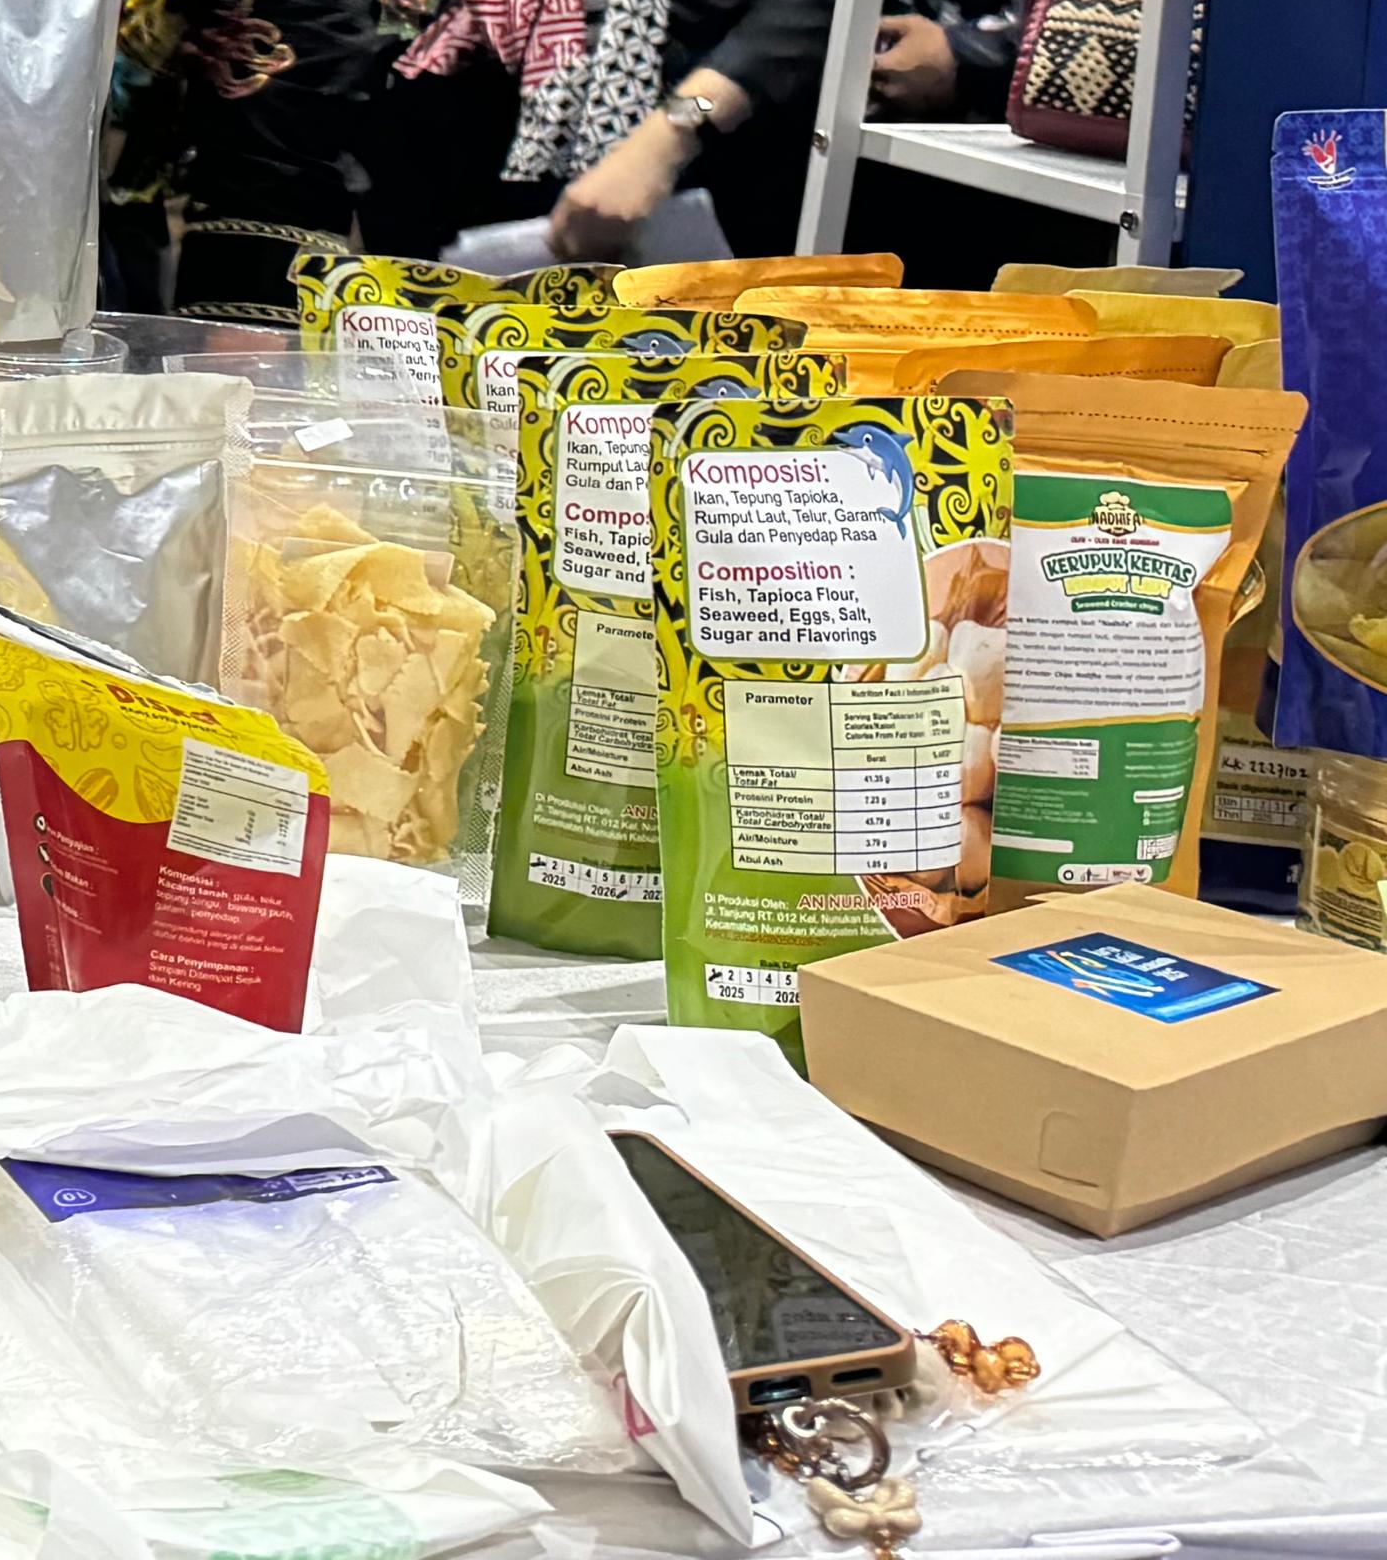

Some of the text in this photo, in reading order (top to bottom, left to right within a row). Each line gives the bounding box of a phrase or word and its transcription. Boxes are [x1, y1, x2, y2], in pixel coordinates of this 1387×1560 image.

[567, 441, 649, 456] Ikan, Tepung
[566, 458, 623, 475] Rumput
[688, 458, 829, 489] Komposisi:
[565, 474, 632, 490] Gula dan
[694, 490, 843, 508] Ikan, Tepung Tapioka,
[694, 508, 886, 527] Rumput Laut, Telur, Garam,
[1091, 510, 1141, 527] NADHIFA
[564, 527, 603, 545] Fish,
[695, 528, 877, 546] Gula dan Penyedap Rasa
[563, 542, 640, 566] Seaweed,
[562, 559, 645, 583] Sugar and
[698, 560, 842, 586] Composition
[1046, 552, 1193, 583] KERUPUK KERTAS
[698, 587, 860, 605] Fish, Tapioca Flour,
[699, 606, 871, 625] Seaweed, Eggs, Salt,
[700, 627, 877, 645] Sugar and Flavorings
[745, 692, 814, 706] Parameter
[732, 768, 768, 778] Lemak
[735, 778, 778, 787] Total Fat
[776, 795, 814, 805] Protein
[737, 817, 832, 831] Total Carbohydrate
[764, 856, 783, 867] Ash
[159, 865, 214, 887] Komposisi
[542, 872, 566, 887] 2025
[158, 877, 196, 894] Kacang
[591, 884, 616, 897] 2026
[705, 892, 716, 903] Di
[717, 894, 758, 908] Produksi
[796, 893, 826, 910] AN
[828, 893, 864, 909] NUR
[867, 891, 926, 909] MANDIRI
[719, 908, 755, 922] Tanjung
[821, 913, 860, 924] Nunukan
[705, 919, 758, 934] Kecamatan
[760, 924, 806, 936] Nunukan
[149, 962, 186, 977] Simpan
[150, 950, 249, 972] Cara Penyimpanan
[169, 976, 201, 992] Kering
[719, 985, 745, 999] 2025
